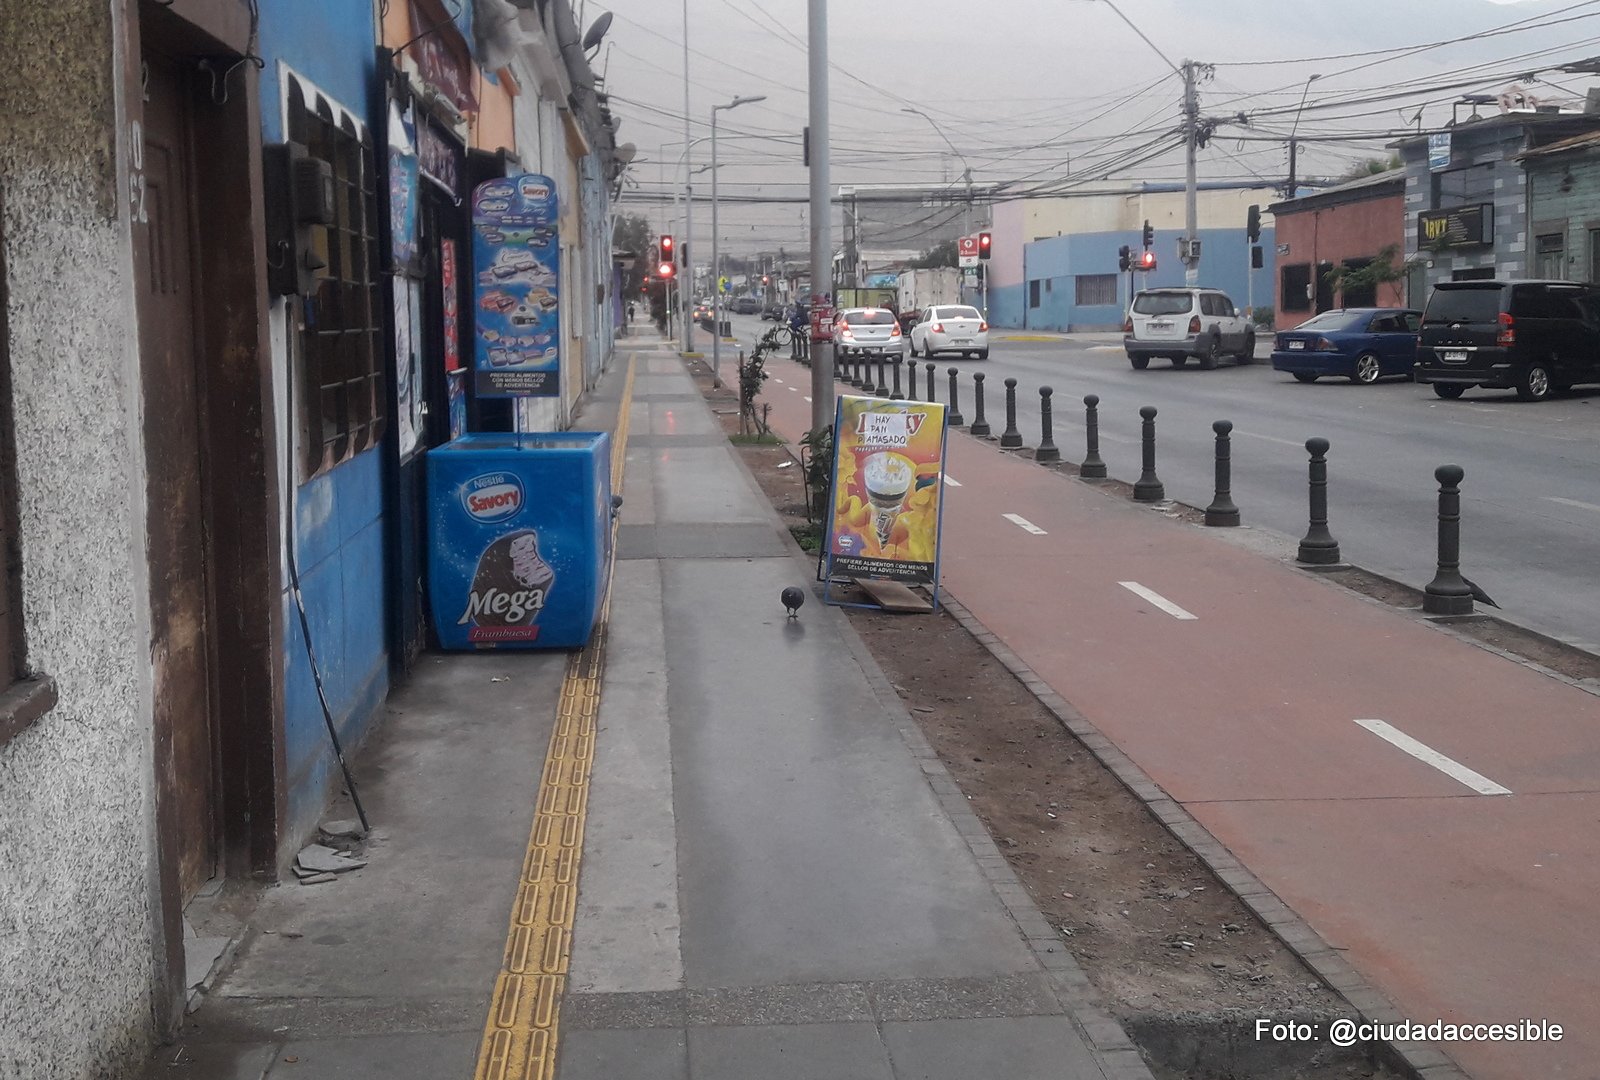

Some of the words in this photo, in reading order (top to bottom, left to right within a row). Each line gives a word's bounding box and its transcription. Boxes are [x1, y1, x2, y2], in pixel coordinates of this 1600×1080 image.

[875, 414, 891, 424] HAY
[870, 424, 887, 433] PAN
[866, 435, 906, 445] AMASADO
[469, 490, 518, 513] Savory
[836, 557, 863, 566] PREFIERE
[863, 560, 895, 568] ALIMENTOS
[877, 567, 917, 575] ADVERTENCIA
[457, 587, 544, 625] Mega
[473, 628, 533, 639] Frambuesa
